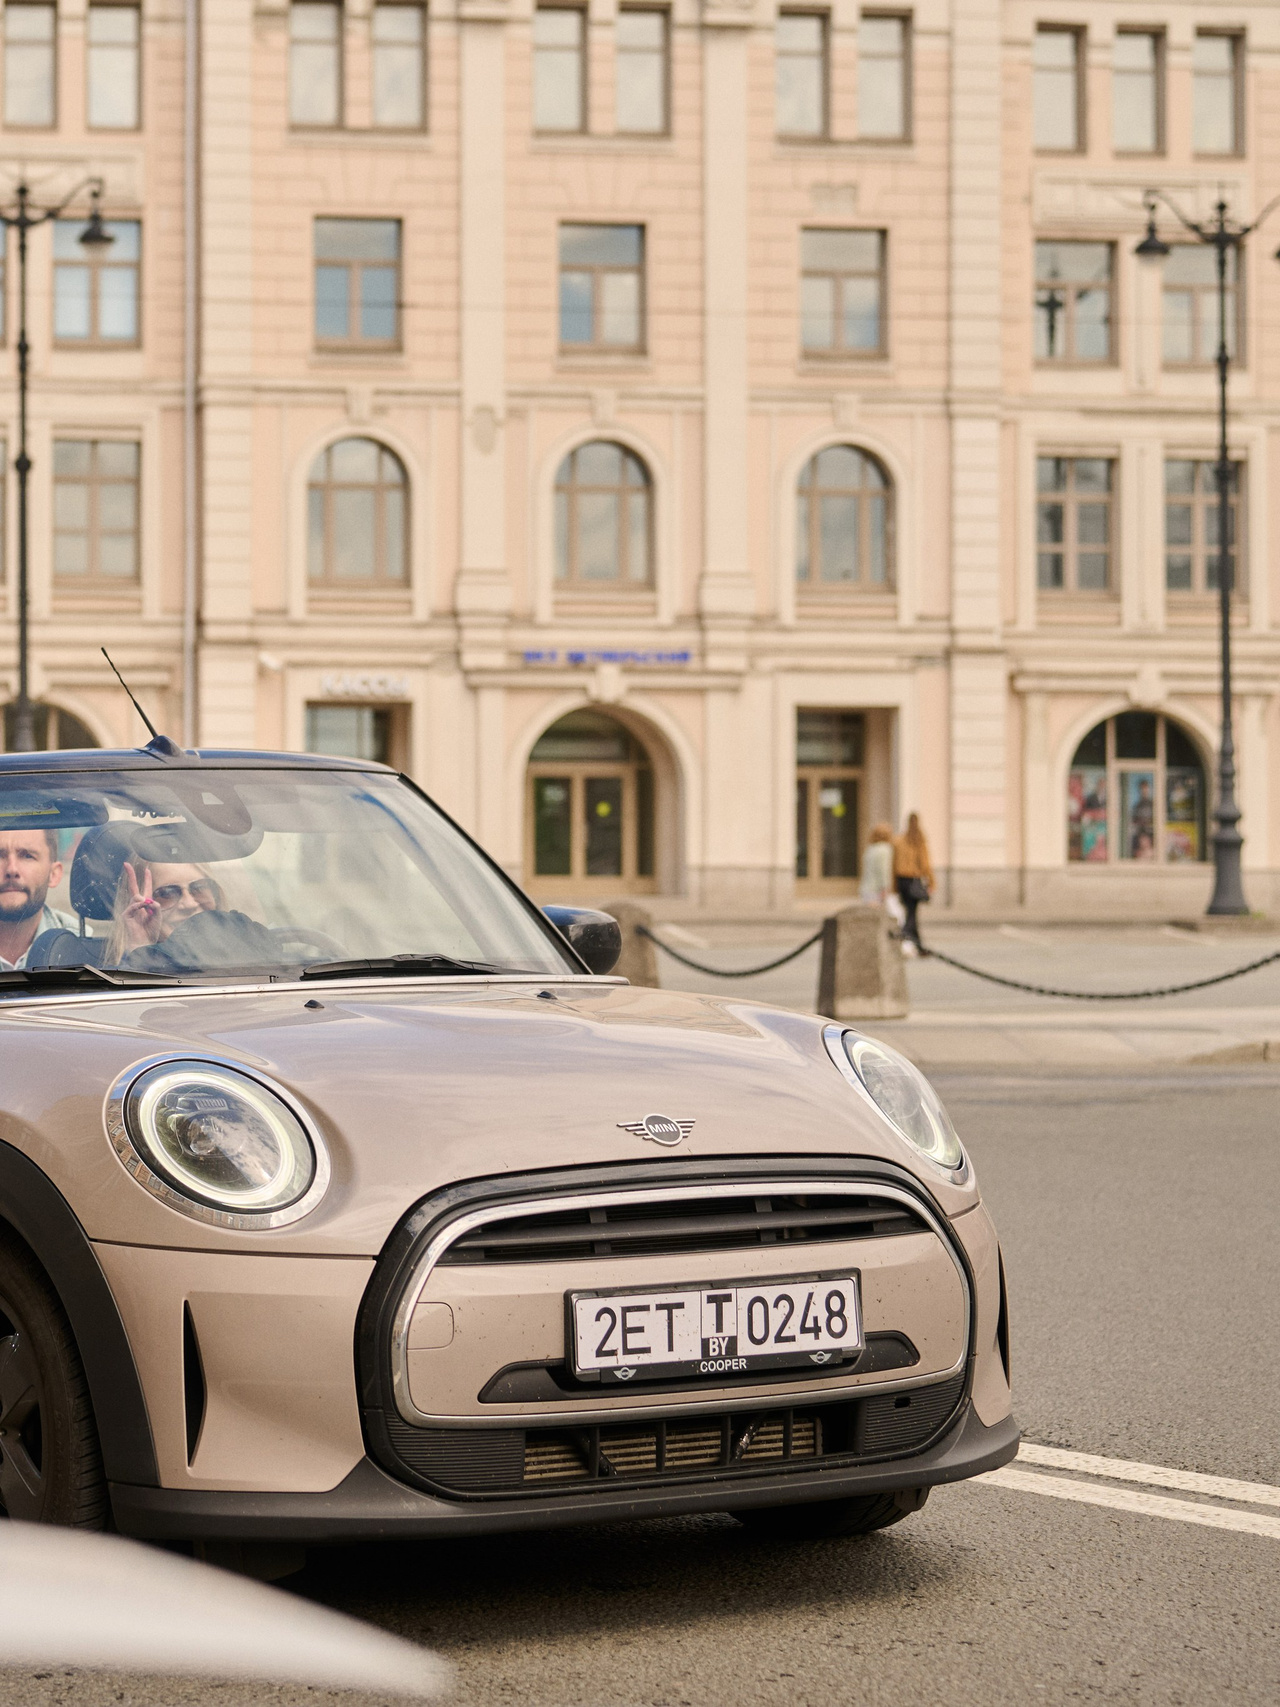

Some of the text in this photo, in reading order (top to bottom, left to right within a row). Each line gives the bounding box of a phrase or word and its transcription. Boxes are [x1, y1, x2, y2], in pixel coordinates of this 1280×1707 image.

[648, 1123, 678, 1133] MINI
[594, 1289, 848, 1358] 2ET T 0248
[709, 1337, 729, 1357] BY
[700, 1358, 747, 1373] COOPER
